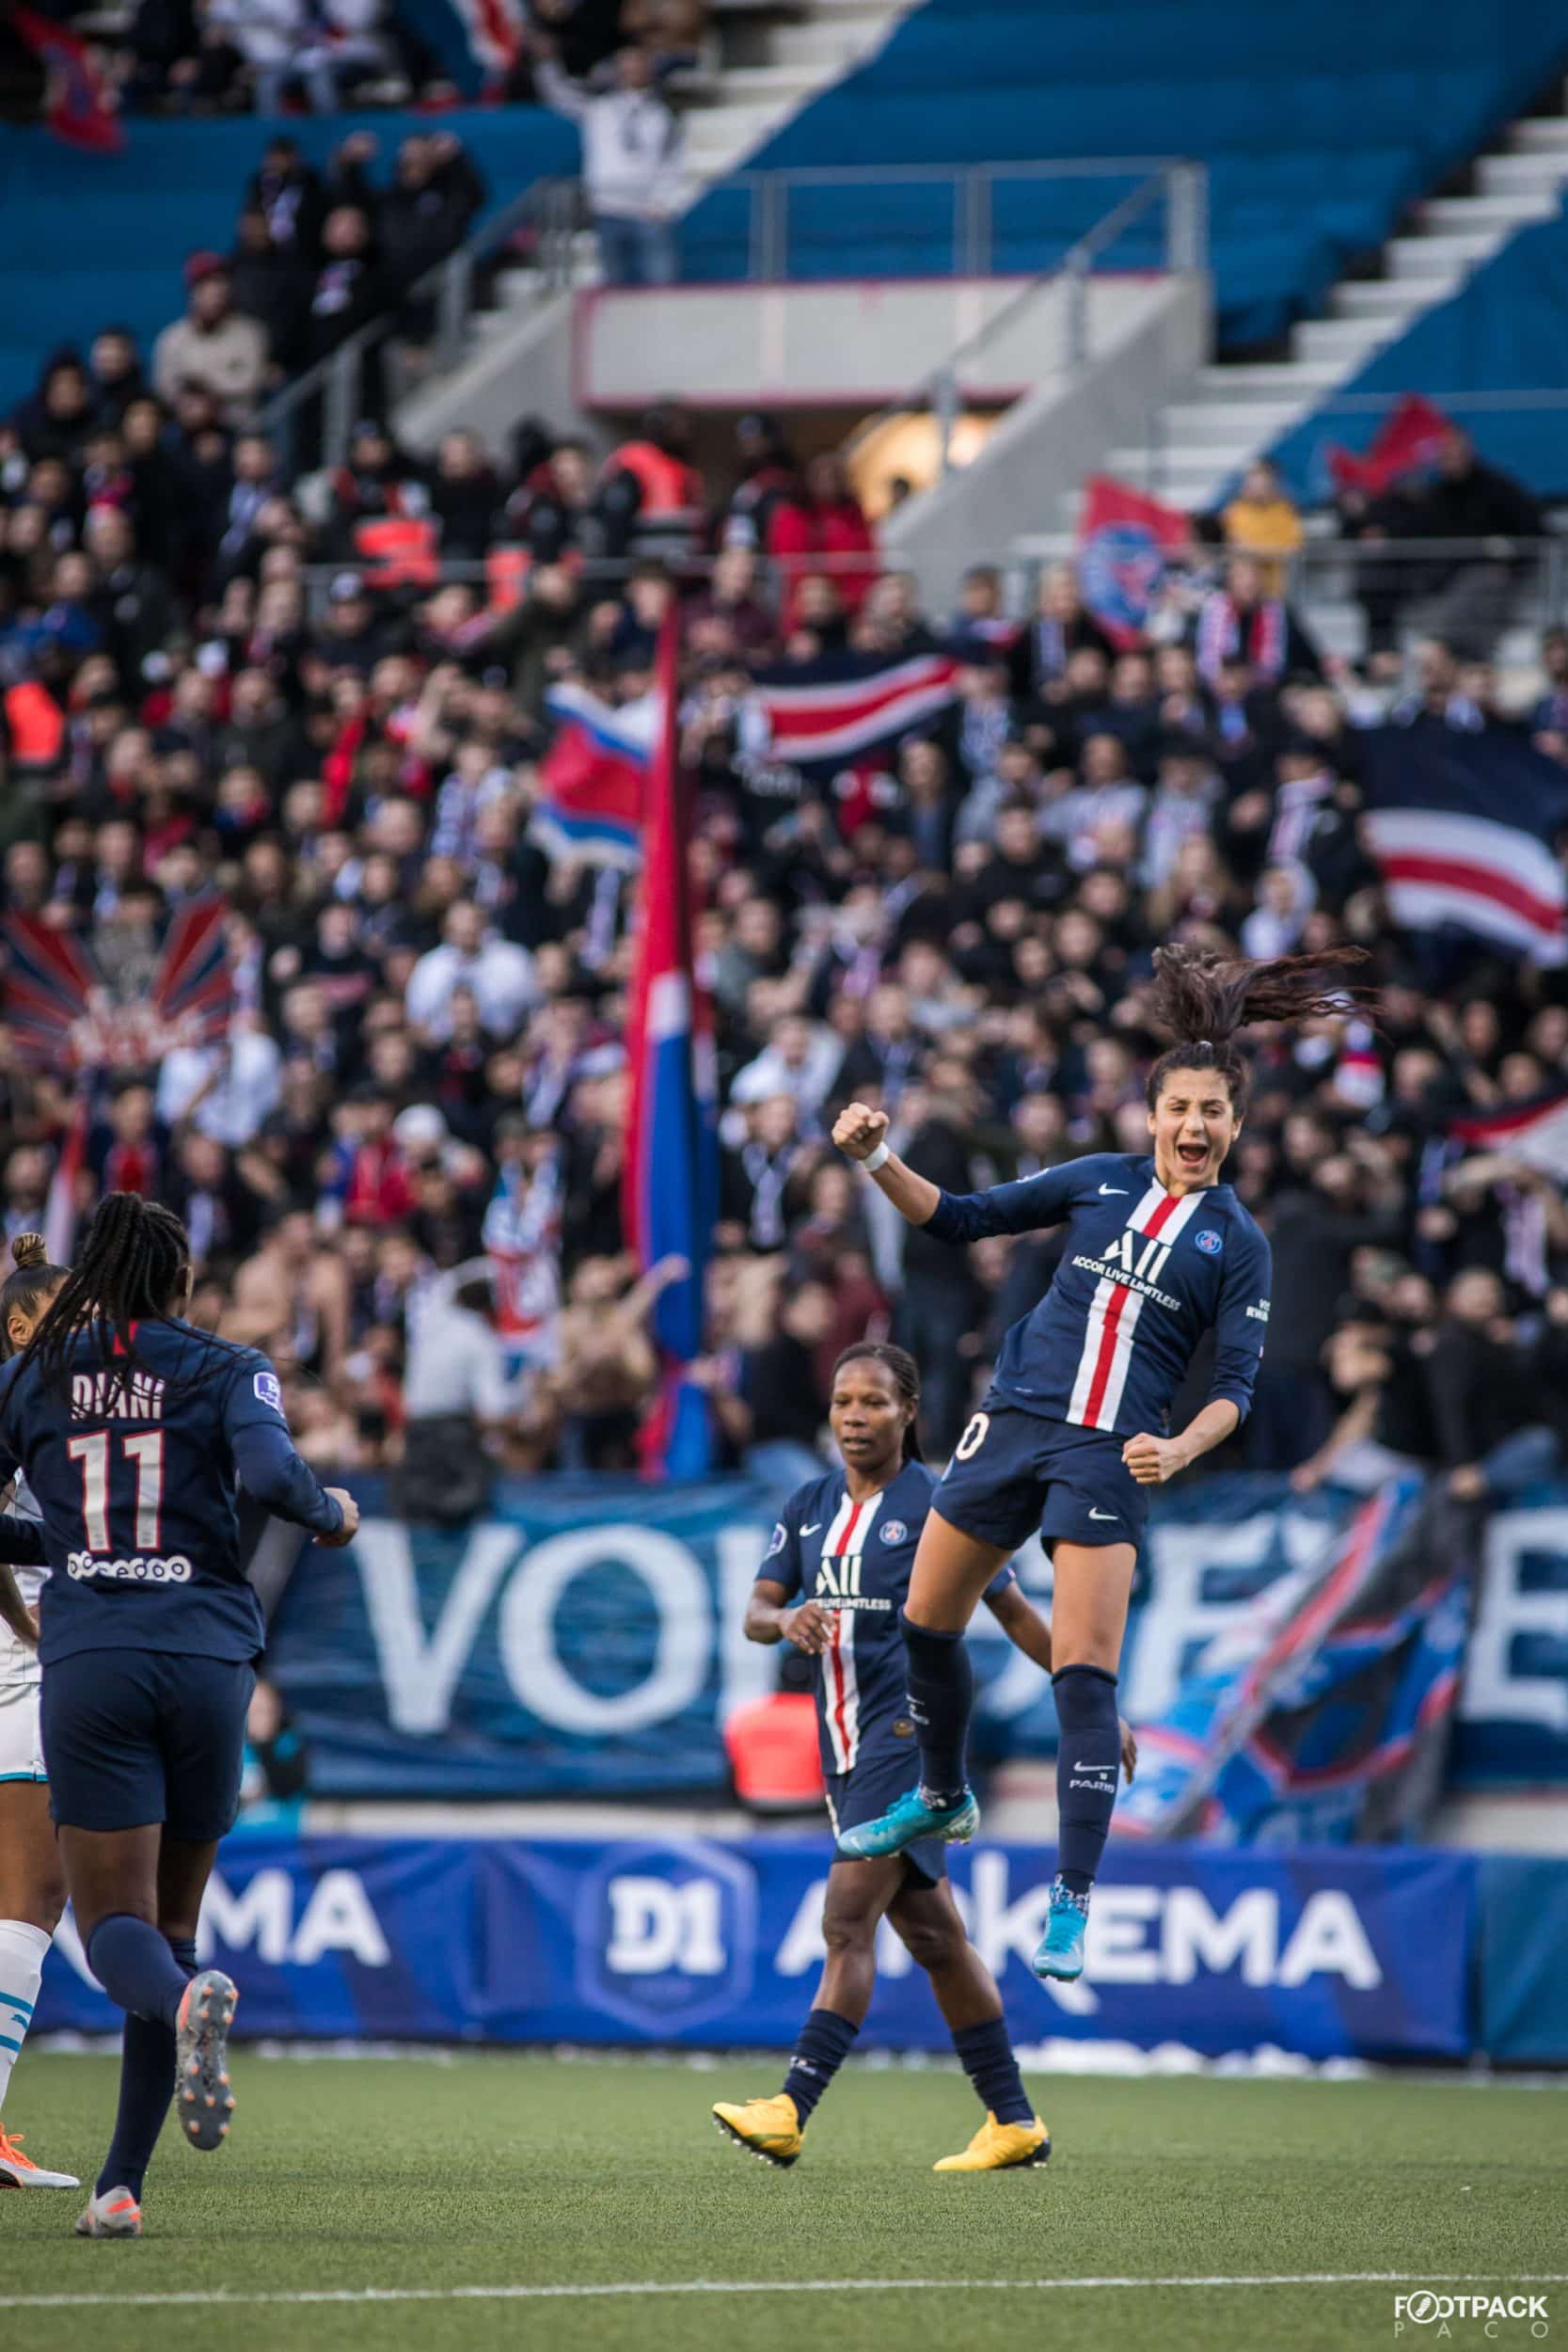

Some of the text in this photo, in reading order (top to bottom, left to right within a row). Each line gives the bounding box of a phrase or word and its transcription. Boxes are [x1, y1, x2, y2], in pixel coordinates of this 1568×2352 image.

[1071, 1254, 1181, 1311] ACCOR LIVE LIMITLESS
[71, 1372, 166, 1420] DIANI
[68, 1428, 164, 1554] 11
[606, 1875, 728, 1975] D1
